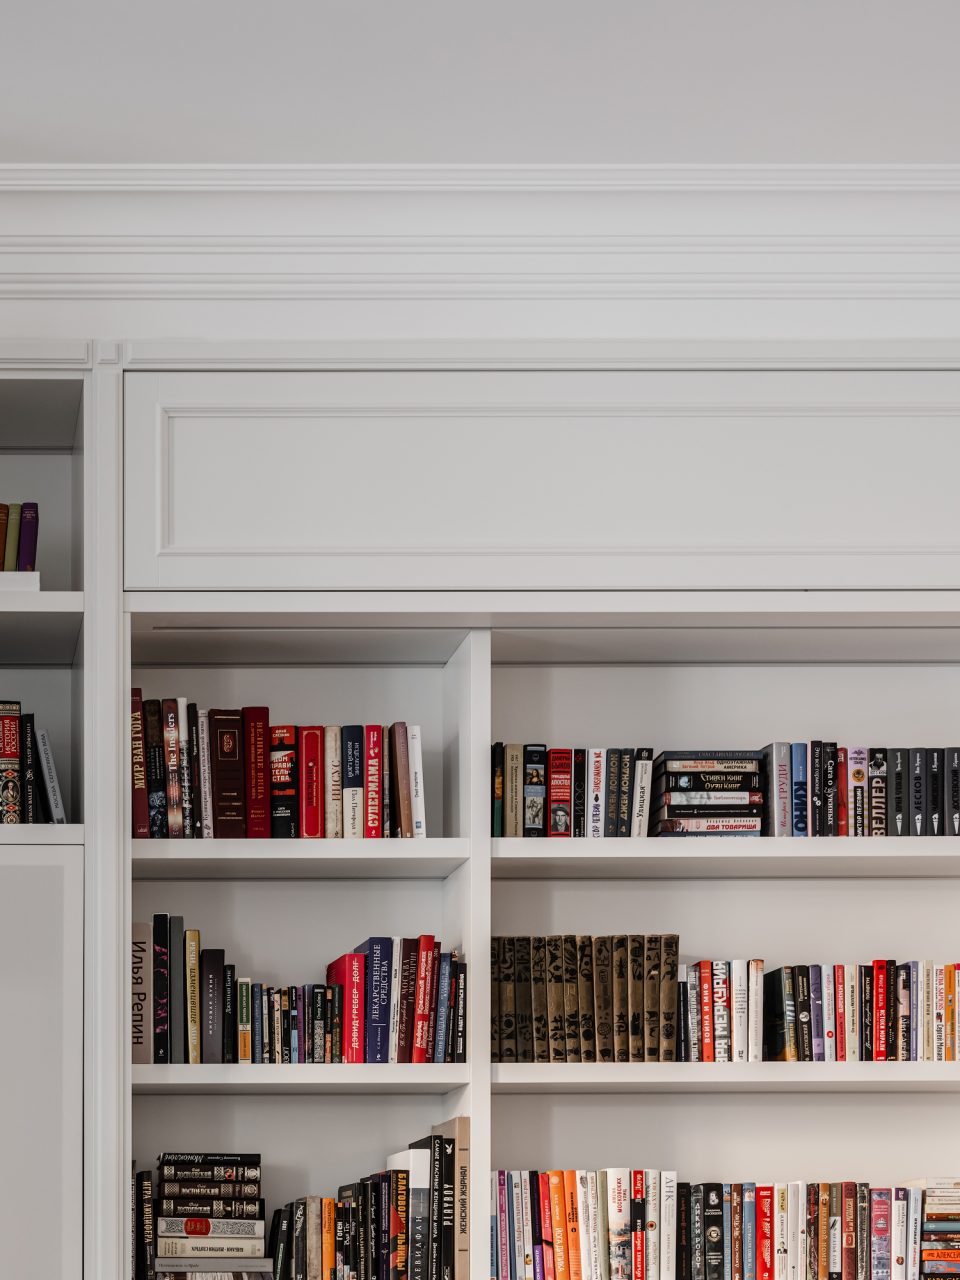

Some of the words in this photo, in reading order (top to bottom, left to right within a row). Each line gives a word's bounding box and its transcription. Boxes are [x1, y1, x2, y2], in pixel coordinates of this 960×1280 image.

[131, 711, 142, 738] ГОГА
[166, 713, 176, 751] Insiders
[132, 740, 144, 762] ВАН
[168, 752, 178, 772] The
[134, 763, 145, 788] МИР
[331, 760, 340, 801] ИИСУС
[609, 753, 618, 792] ЛОНДОН
[620, 754, 630, 793] ЛОНДОН
[778, 764, 788, 800] ГРУДИ
[50, 785, 60, 808] МОСКВА
[368, 758, 379, 827] СУПЕРМАМА
[574, 782, 584, 815] ИИСУС
[609, 793, 617, 820] ДЖЕК
[620, 794, 628, 821] ДЖЕК
[636, 785, 646, 819] Улицкая
[793, 781, 807, 833] КИНО
[855, 788, 863, 815] ПЕЛЕВИН
[871, 777, 886, 837] ВЕЛЛЕР
[913, 775, 922, 812] ЛЕСКОВ
[132, 941, 147, 985] Илья
[401, 959, 409, 994] МОСКВА
[189, 967, 197, 1024] изменившие
[371, 944, 381, 1020] ЛЕКАРСТВЕННЫЕ
[380, 960, 388, 1005] СРЕДСТВА
[713, 960, 727, 1035] МЕРКУРИЯ
[132, 992, 147, 1045] Репин
[351, 988, 359, 1019] ГРЕБЕР
[351, 1019, 359, 1049] ДЭВИД
[702, 1014, 710, 1044] ВОЙНА
[142, 1181, 151, 1200] ИГРА
[459, 1165, 468, 1197] ЖУРНАЛ
[665, 1177, 675, 1202] ДНК
[442, 1183, 454, 1226] PLAYBOY
[458, 1198, 468, 1234] ЖЕНСКИЙ
[143, 1203, 152, 1242] ЛЮЦИФЕРА
[336, 1221, 344, 1241] Гоген
[554, 1227, 565, 1245] ЙОГА
